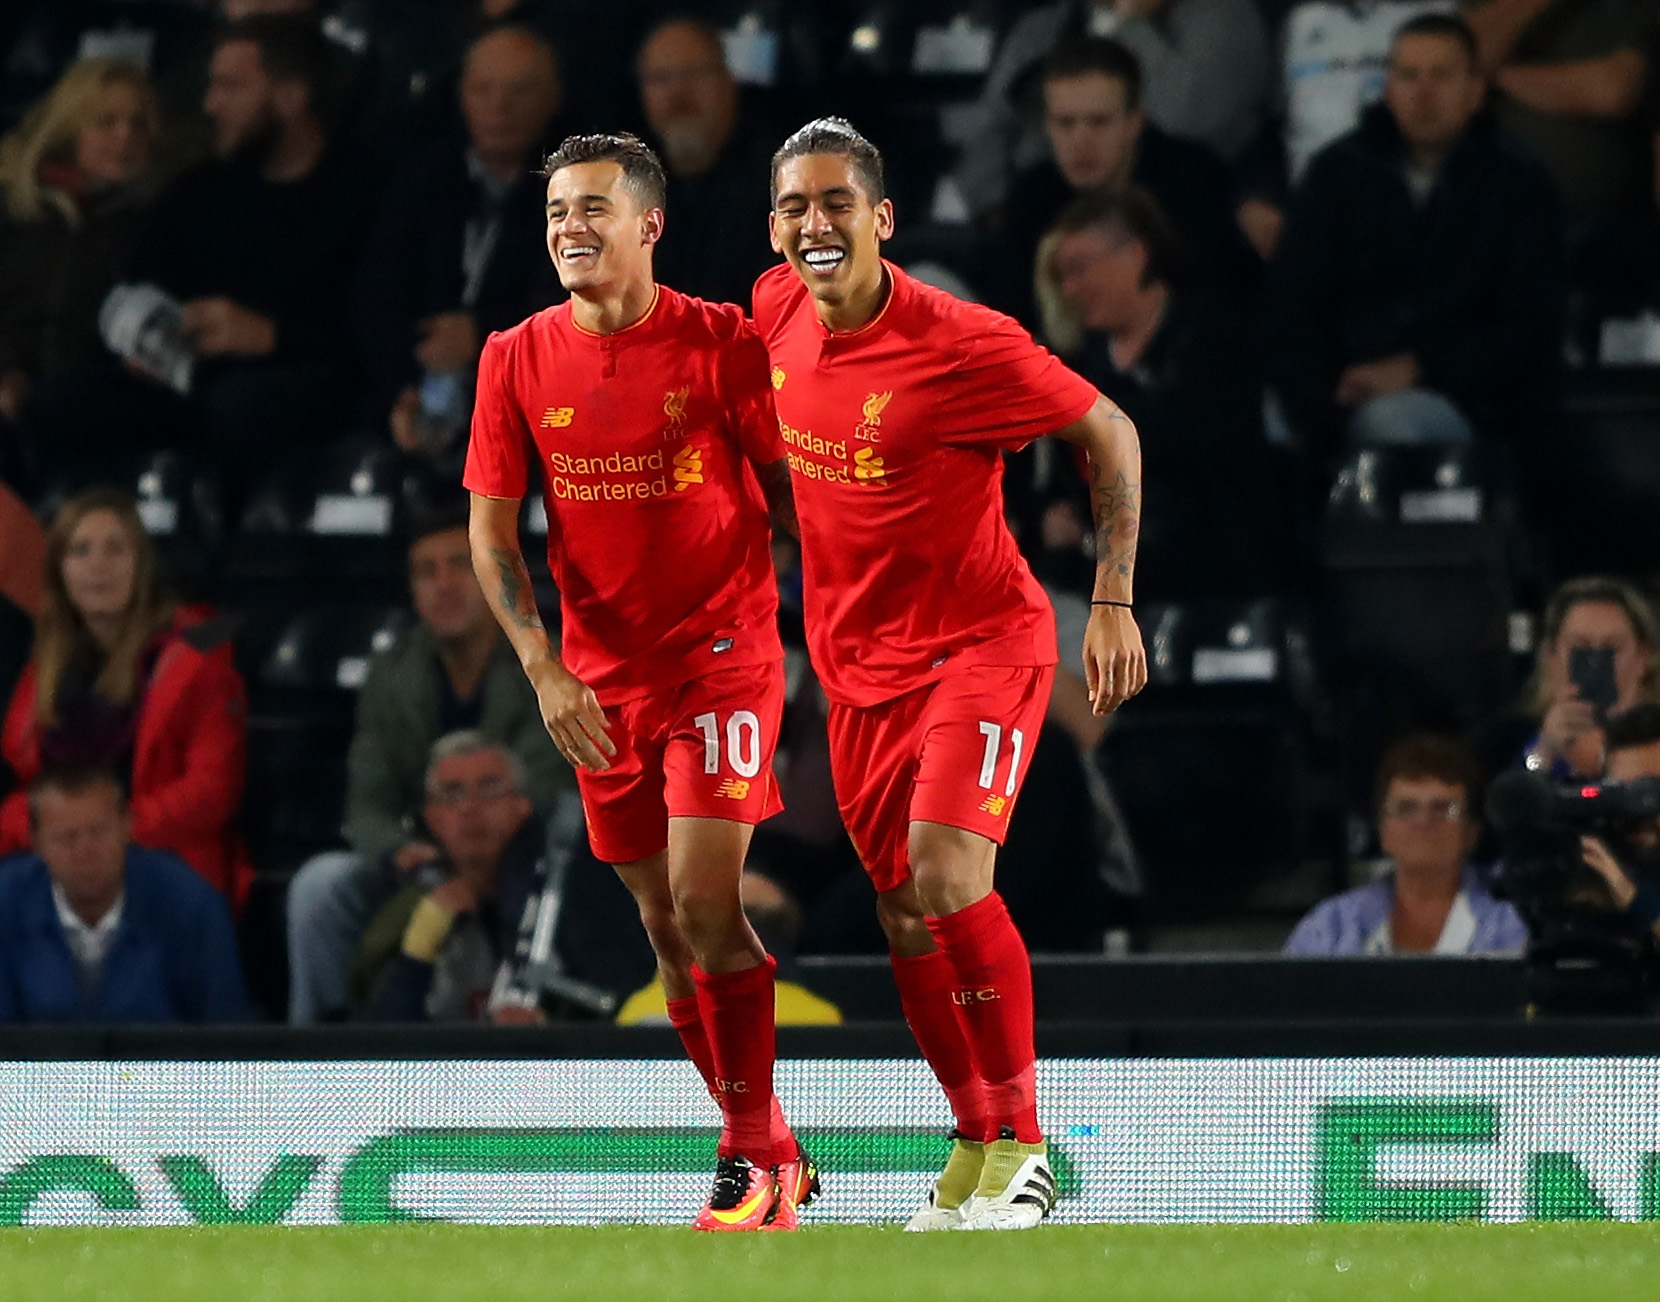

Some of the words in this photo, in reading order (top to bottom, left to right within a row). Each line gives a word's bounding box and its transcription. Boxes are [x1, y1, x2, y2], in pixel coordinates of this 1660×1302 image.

[777, 416, 847, 460] tandard
[551, 449, 663, 474] Standard
[786, 450, 851, 484] artered
[553, 475, 667, 501] Chartered
[694, 710, 760, 778] 10
[978, 721, 1023, 797] 11
